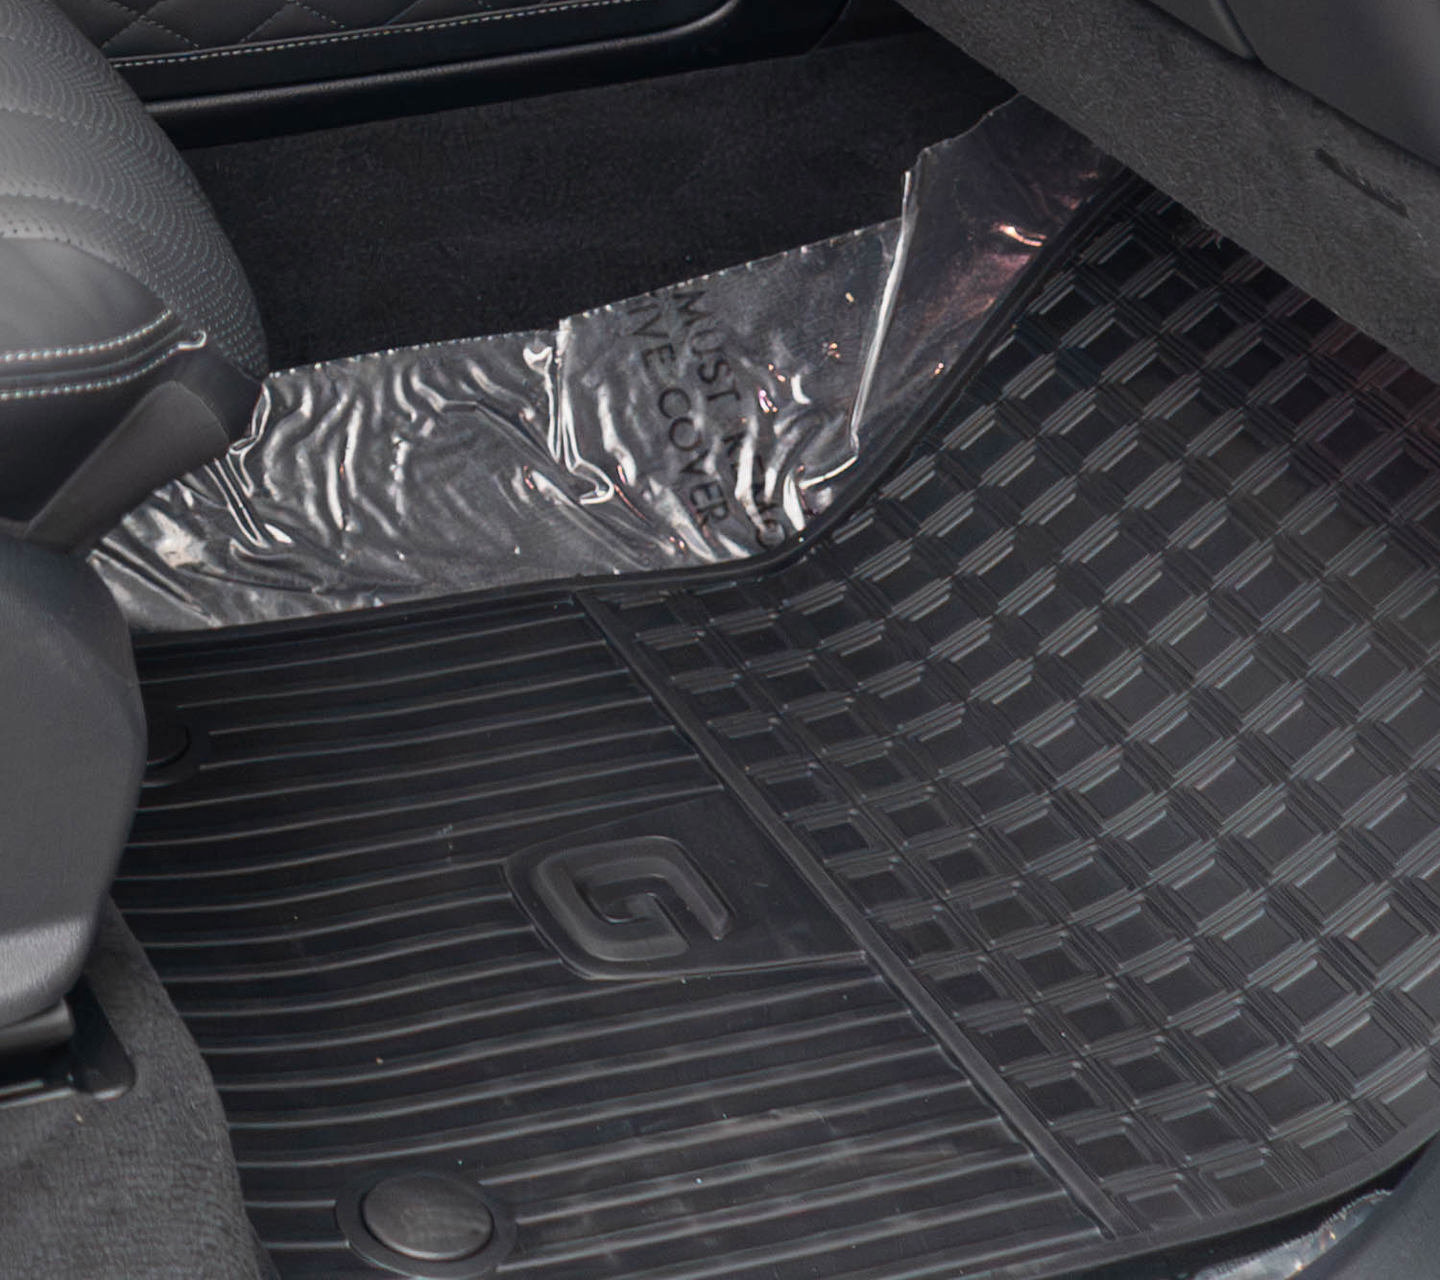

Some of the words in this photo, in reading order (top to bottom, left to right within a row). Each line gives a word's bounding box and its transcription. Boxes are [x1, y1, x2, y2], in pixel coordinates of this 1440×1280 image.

[626, 294, 677, 370] IVE
[657, 387, 729, 525] COVER
[672, 290, 741, 402] MUST
